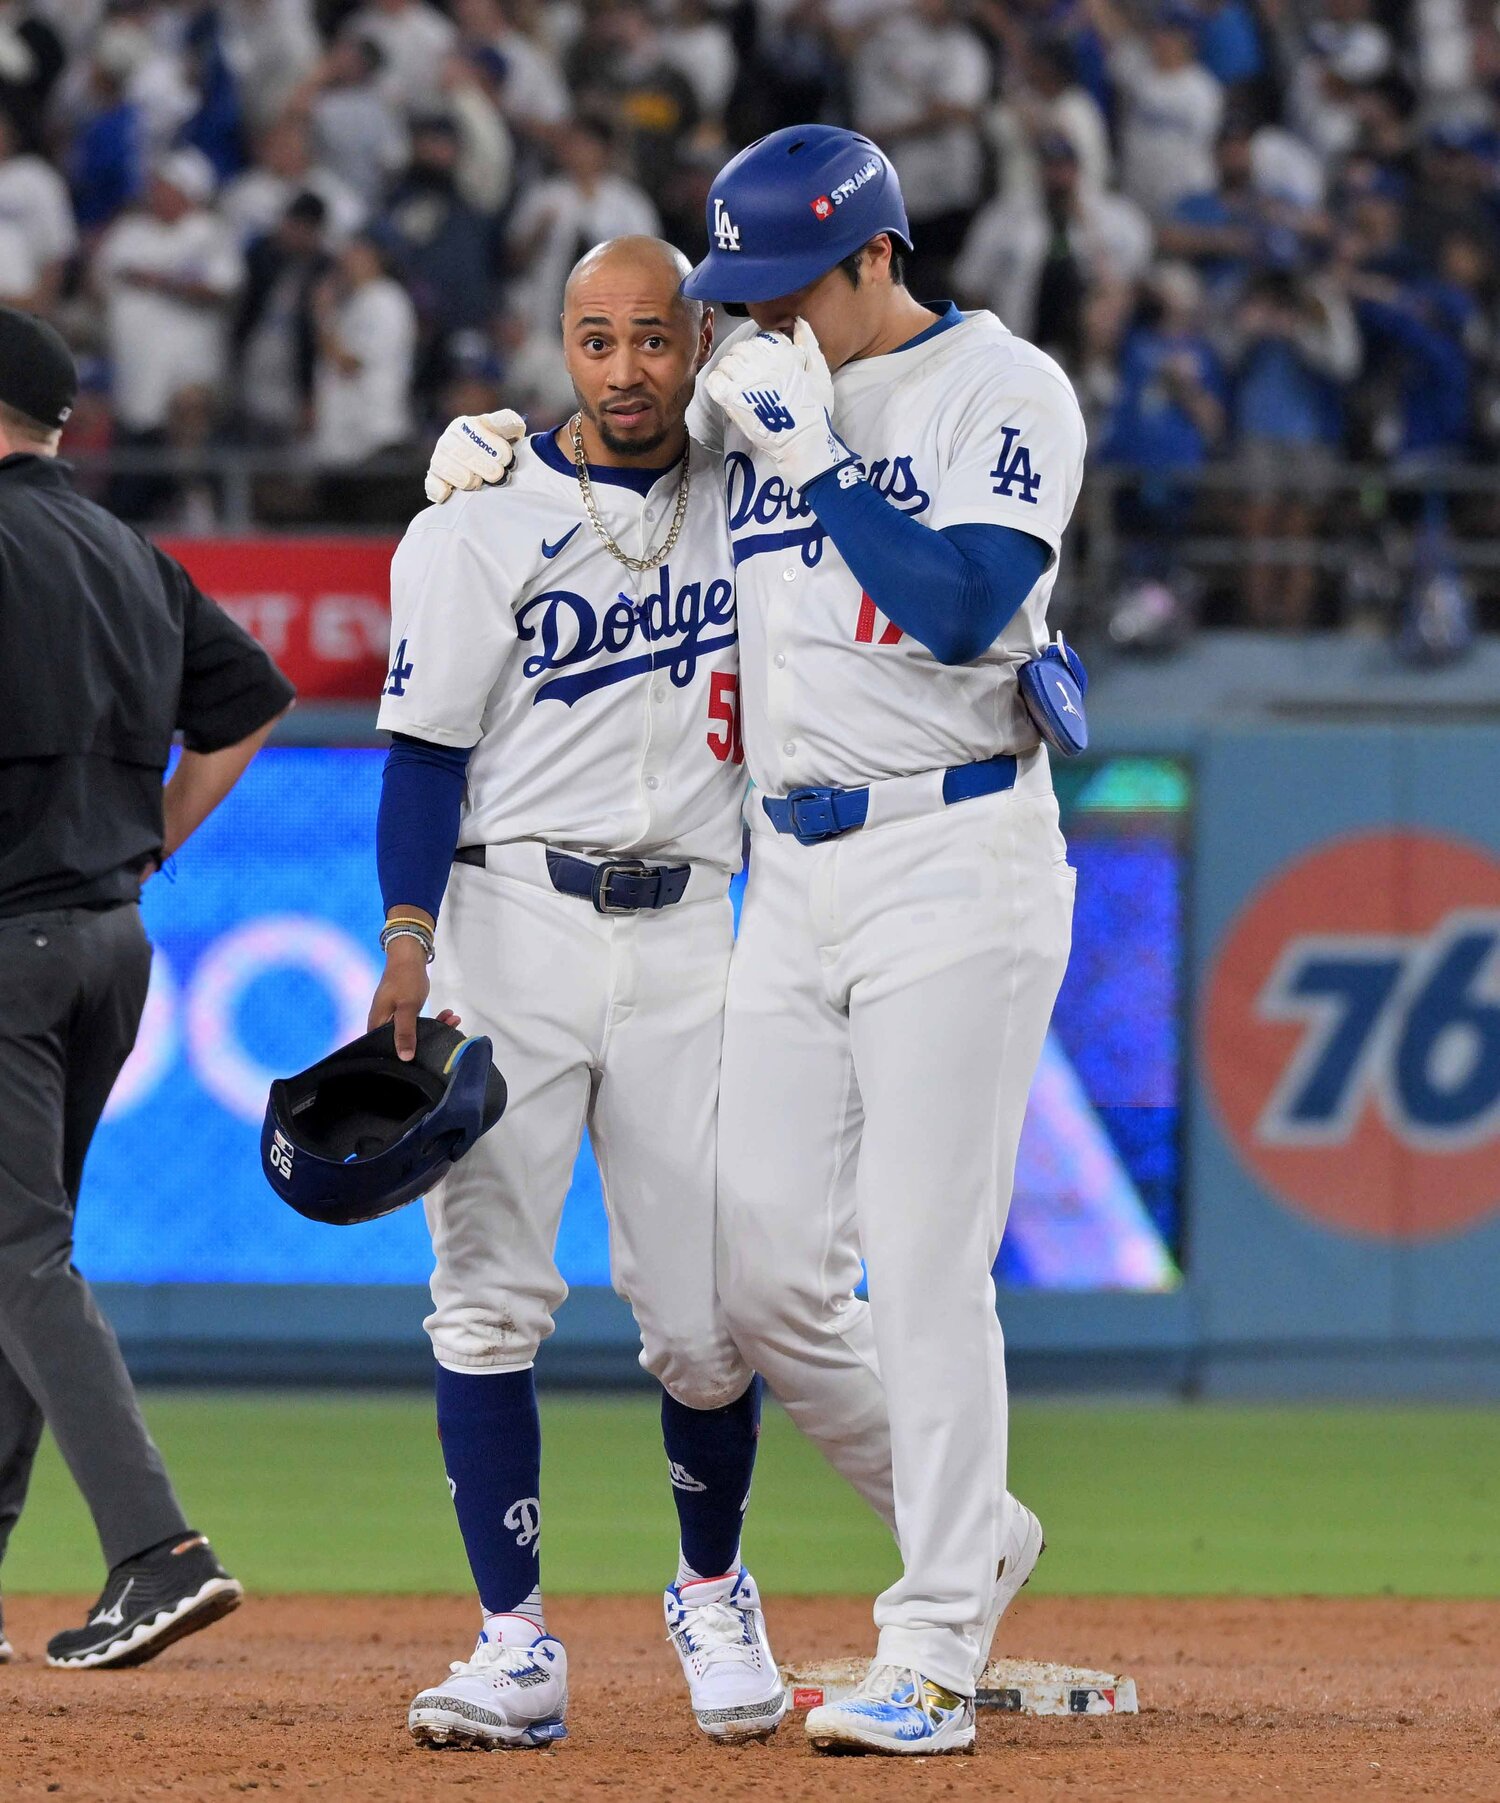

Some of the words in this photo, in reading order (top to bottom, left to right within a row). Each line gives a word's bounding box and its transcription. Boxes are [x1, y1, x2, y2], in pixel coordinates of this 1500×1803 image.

[713, 198, 741, 251] LA
[469, 430, 499, 458] balance
[989, 426, 1042, 504] LA
[515, 564, 736, 688] Dodge
[1265, 912, 1500, 1148] 76
[269, 1144, 293, 1181] 50
